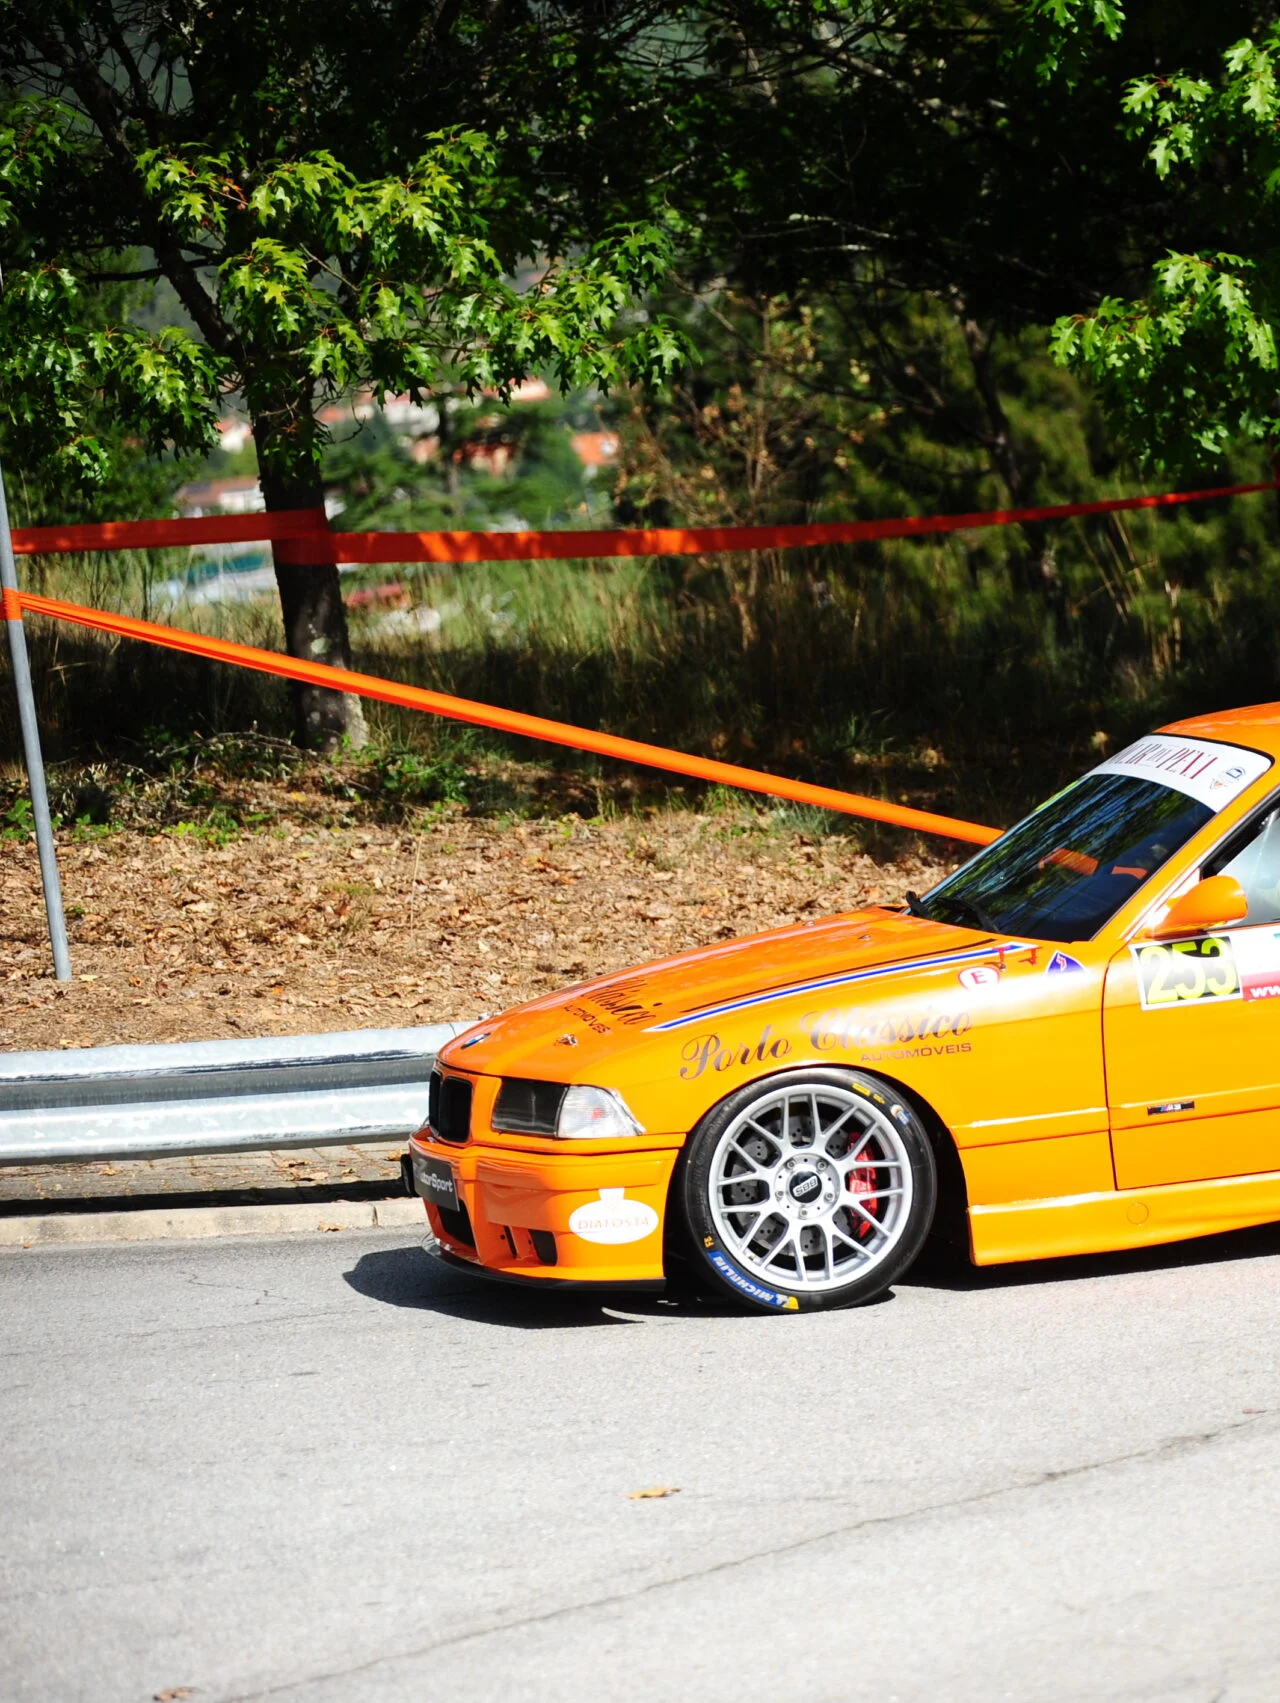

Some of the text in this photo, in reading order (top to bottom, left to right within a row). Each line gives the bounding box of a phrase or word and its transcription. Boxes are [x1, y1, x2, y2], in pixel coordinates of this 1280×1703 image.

[1139, 937, 1238, 1005] 253
[679, 1004, 974, 1081] Porto Clássico
[860, 1042, 973, 1063] AUTOMÓVEIS
[712, 1255, 775, 1302] MICHELIN
